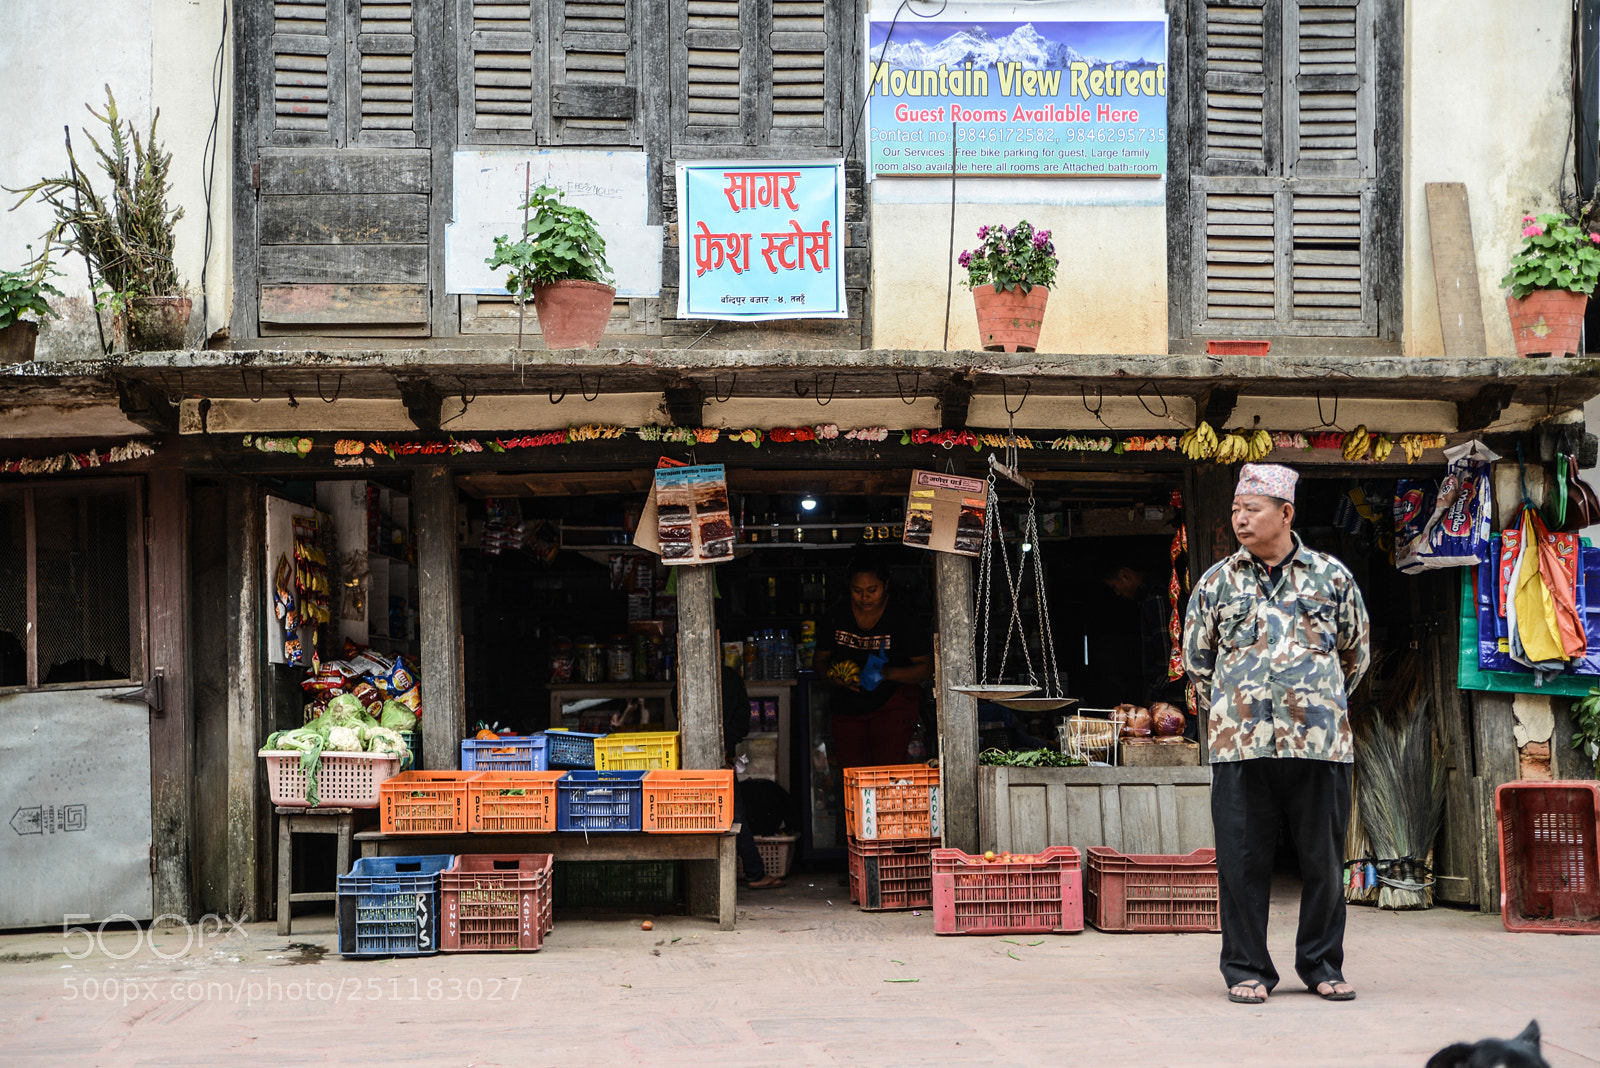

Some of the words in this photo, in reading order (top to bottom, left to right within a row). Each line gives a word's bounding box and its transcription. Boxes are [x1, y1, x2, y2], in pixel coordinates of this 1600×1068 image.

[870, 61, 988, 97] Mountain
[996, 61, 1061, 97] View
[1070, 61, 1166, 101] Retreat
[895, 103, 944, 123] Guest
[950, 104, 1007, 123] Rooms
[1012, 104, 1091, 123] Available
[1097, 104, 1139, 123] Here
[870, 127, 923, 142] Contact
[929, 130, 951, 142] no:
[958, 127, 1060, 144] 9846172582,
[1066, 127, 1166, 143] 9846295735
[882, 147, 901, 157] Our
[904, 147, 945, 157] Services
[955, 147, 977, 157] Free
[980, 147, 1000, 157] bike
[1003, 147, 1039, 159] parking
[1042, 147, 1055, 157] for
[1091, 148, 1118, 159] Large
[1121, 148, 1150, 159] family
[874, 163, 899, 171] room
[902, 161, 922, 171] also
[971, 161, 993, 171] here
[996, 162, 1007, 171] all
[1010, 163, 1040, 171] rooms
[1043, 163, 1059, 171] are
[1062, 162, 1104, 171] Attached
[1107, 162, 1158, 171] bath-room
[723, 171, 801, 213] सागर
[693, 220, 752, 277] फ्रेश
[760, 219, 832, 274] स्टोर्स
